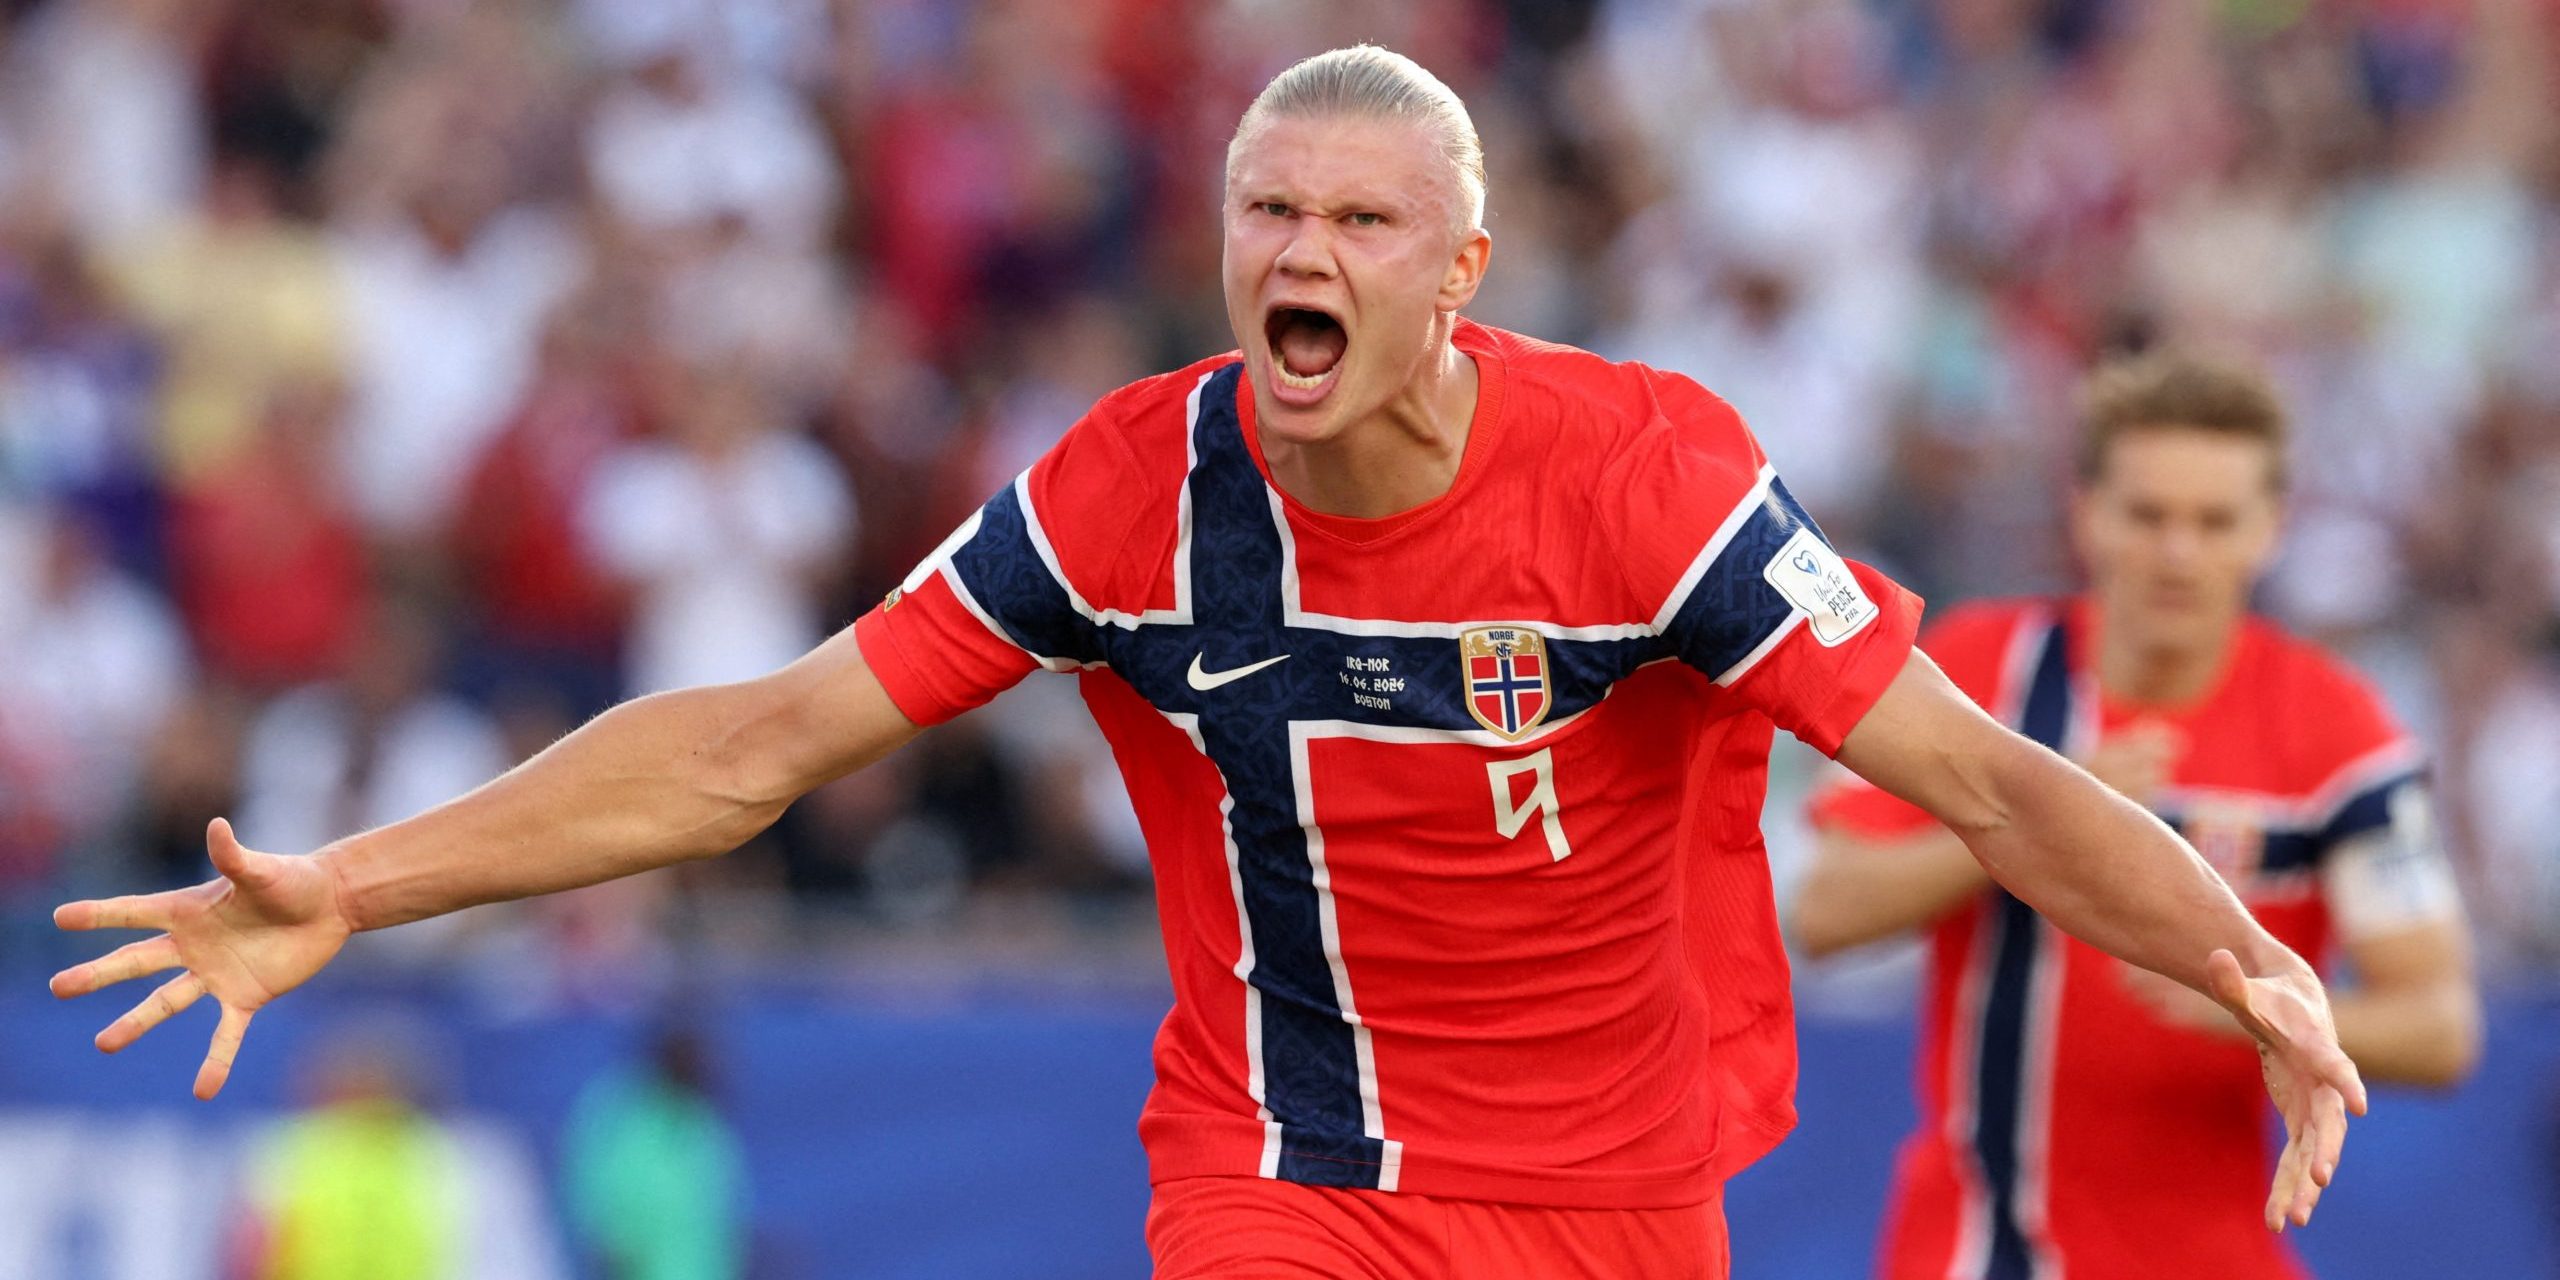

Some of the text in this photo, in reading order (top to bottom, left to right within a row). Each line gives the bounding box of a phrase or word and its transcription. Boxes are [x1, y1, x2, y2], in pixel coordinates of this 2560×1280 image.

[1844, 607, 1860, 624] FIFA
[1488, 630, 1515, 641] NORGE
[1346, 656, 1390, 671] IRQ-NOR
[1353, 692, 1391, 710] BOSTON
[1486, 746, 1572, 863] 9
